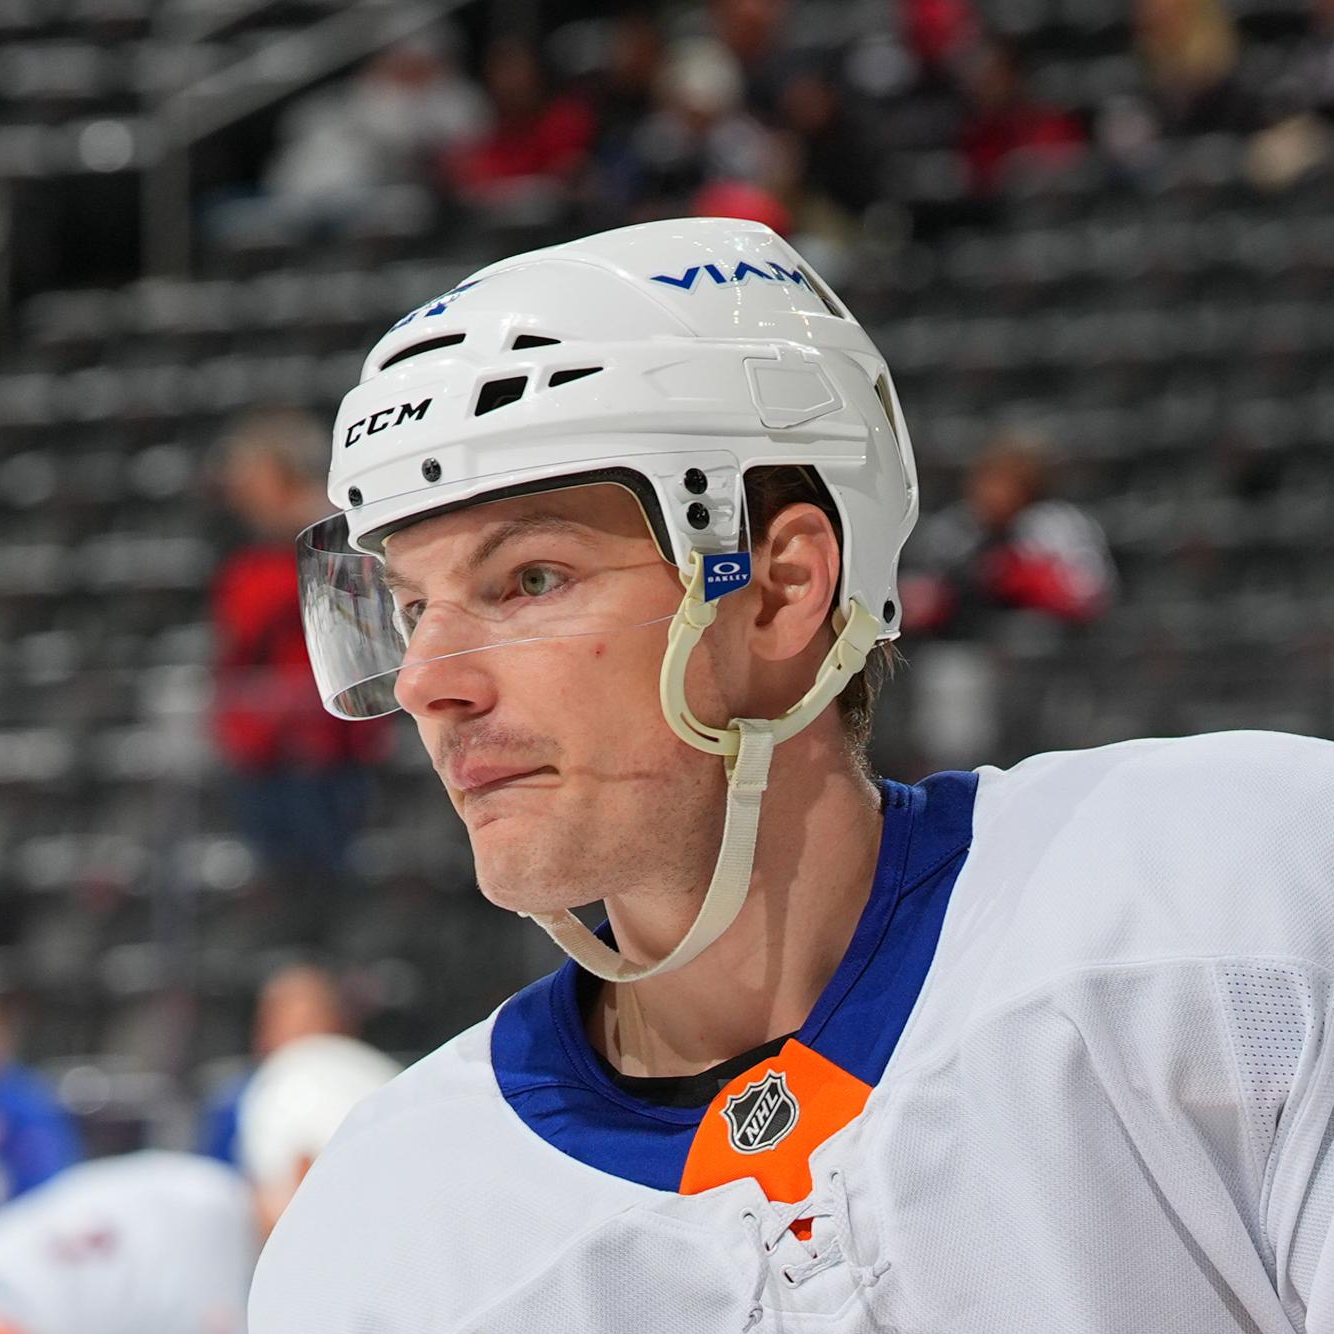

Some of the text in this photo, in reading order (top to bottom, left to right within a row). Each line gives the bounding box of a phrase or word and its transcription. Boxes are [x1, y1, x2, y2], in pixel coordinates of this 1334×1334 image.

[650, 260, 815, 293] VIAM
[345, 398, 434, 449] CCM
[707, 573, 748, 583] OAKLEY
[745, 1092, 779, 1144] NHL
